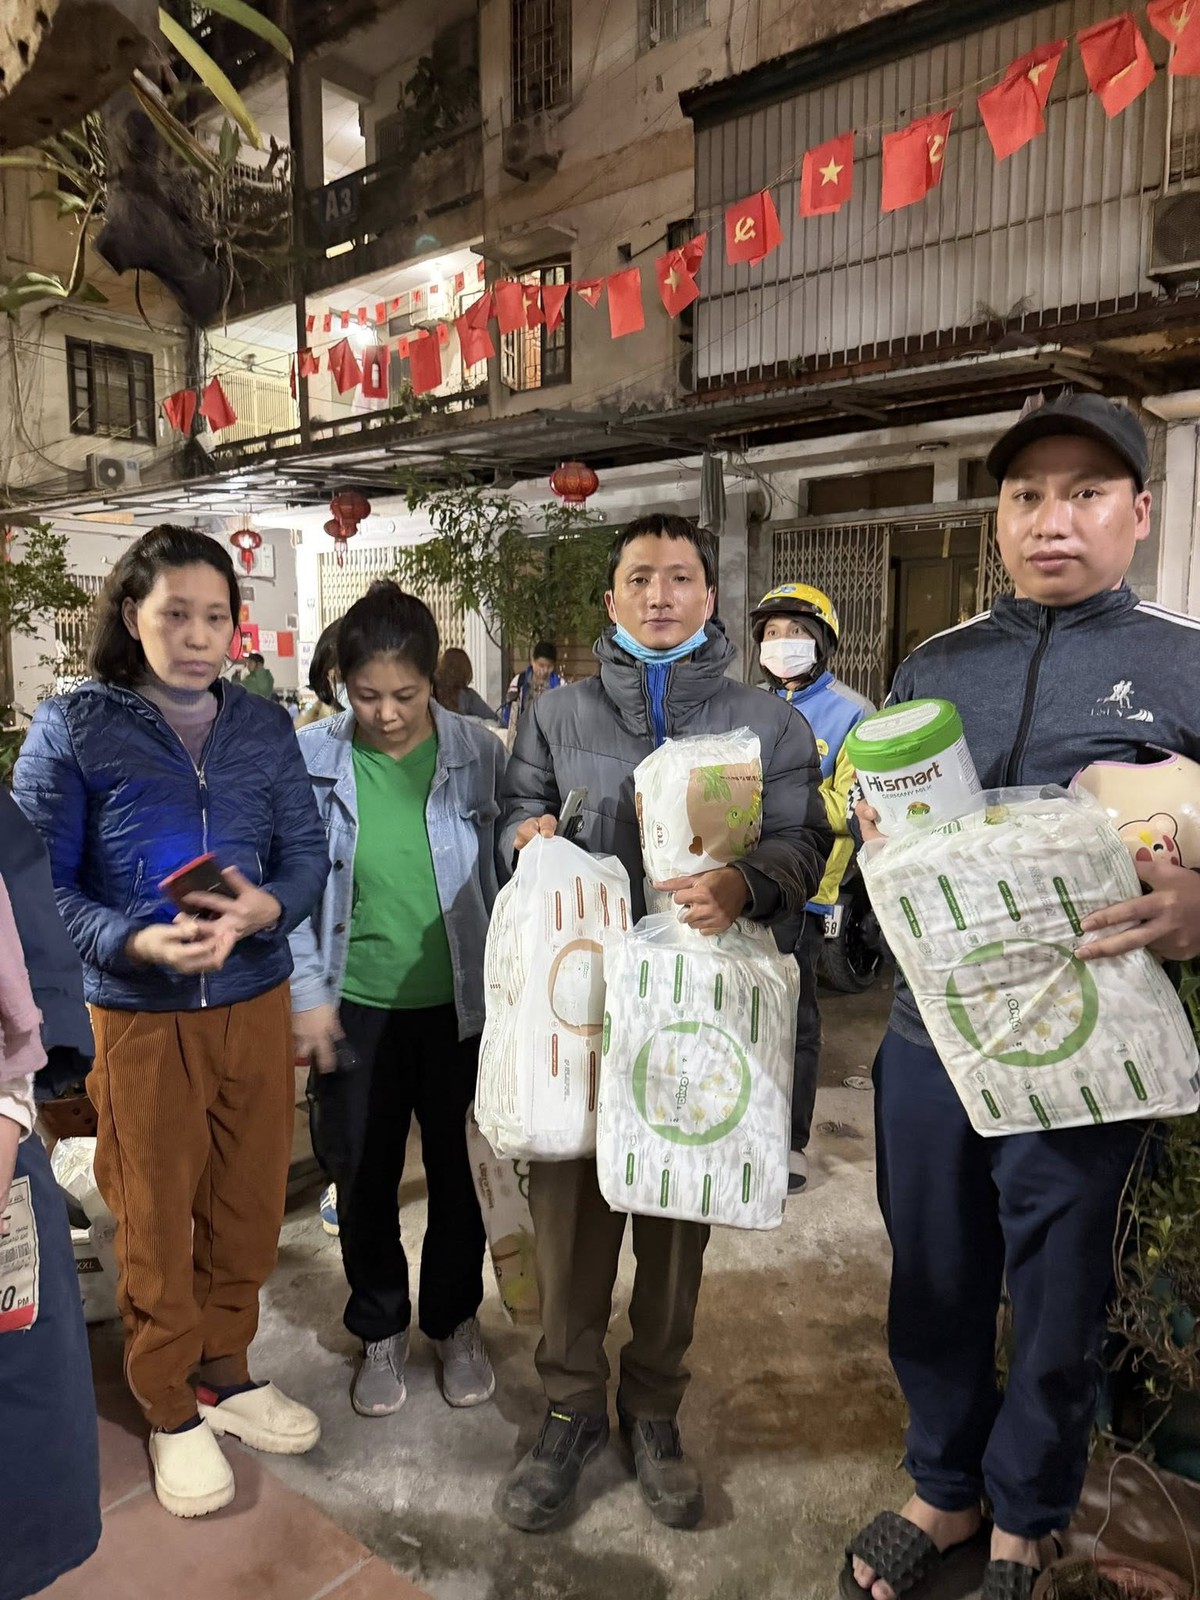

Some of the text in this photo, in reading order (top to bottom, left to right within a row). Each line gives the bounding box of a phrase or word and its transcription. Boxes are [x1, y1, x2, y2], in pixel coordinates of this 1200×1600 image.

[325, 188, 352, 221] A3
[866, 762, 942, 792] Hismart
[881, 785, 931, 800] GERMANY MILK
[76, 1261, 94, 1270] XXL
[0, 1285, 29, 1312] 0 PM
